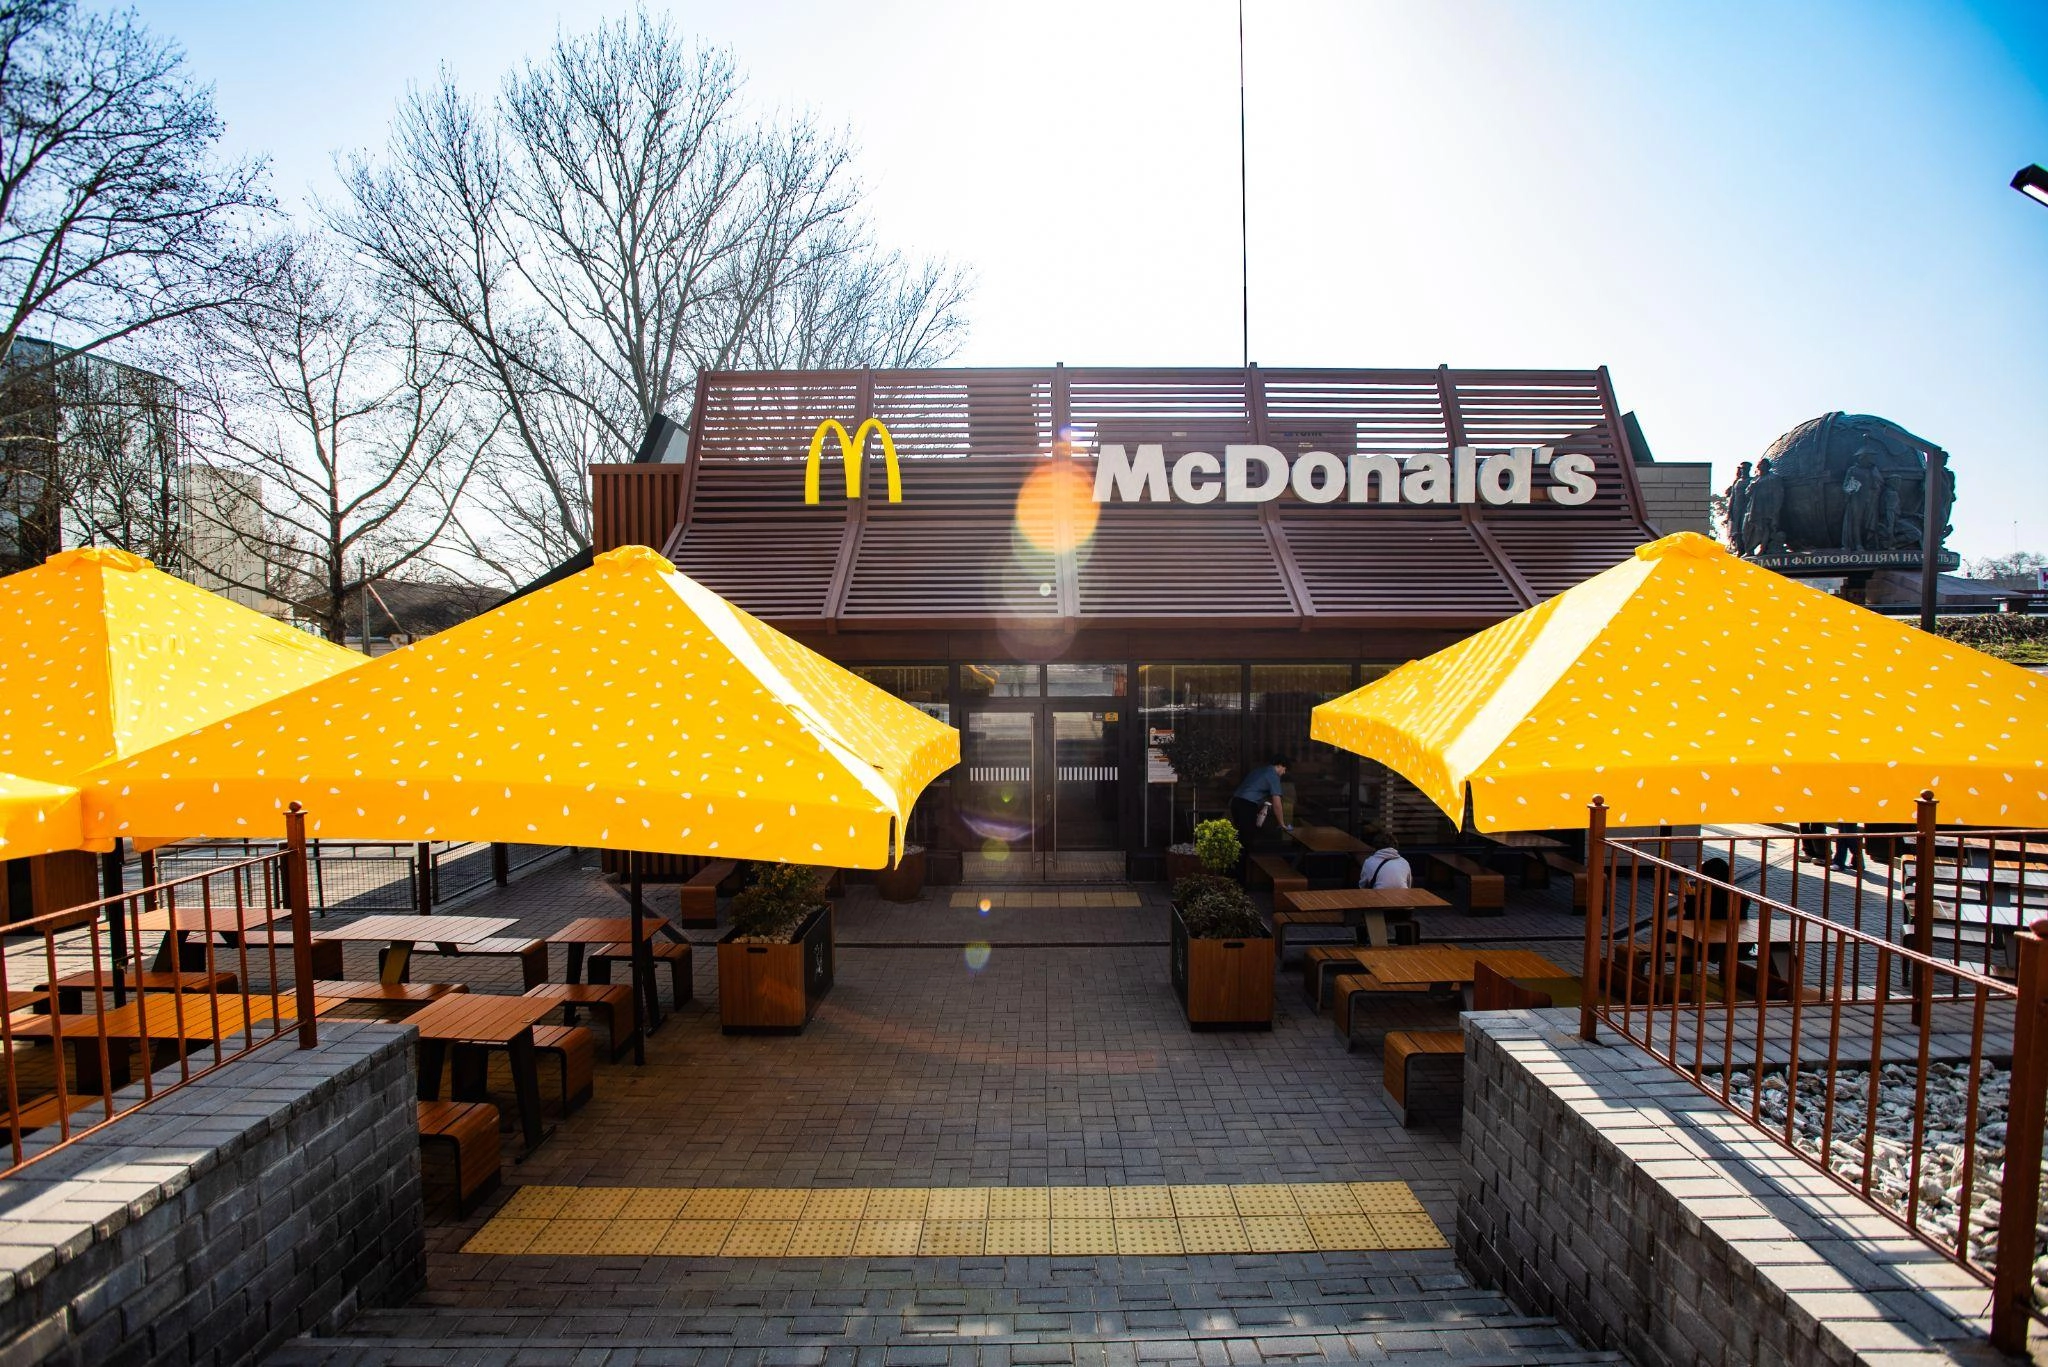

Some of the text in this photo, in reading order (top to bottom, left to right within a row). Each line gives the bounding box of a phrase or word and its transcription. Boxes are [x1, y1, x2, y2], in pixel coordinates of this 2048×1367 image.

[1092, 444, 1598, 505] McDonald's
[1791, 553, 1899, 566] ФЛОТОВОДЦЯМ
[1903, 553, 1920, 562] НА
